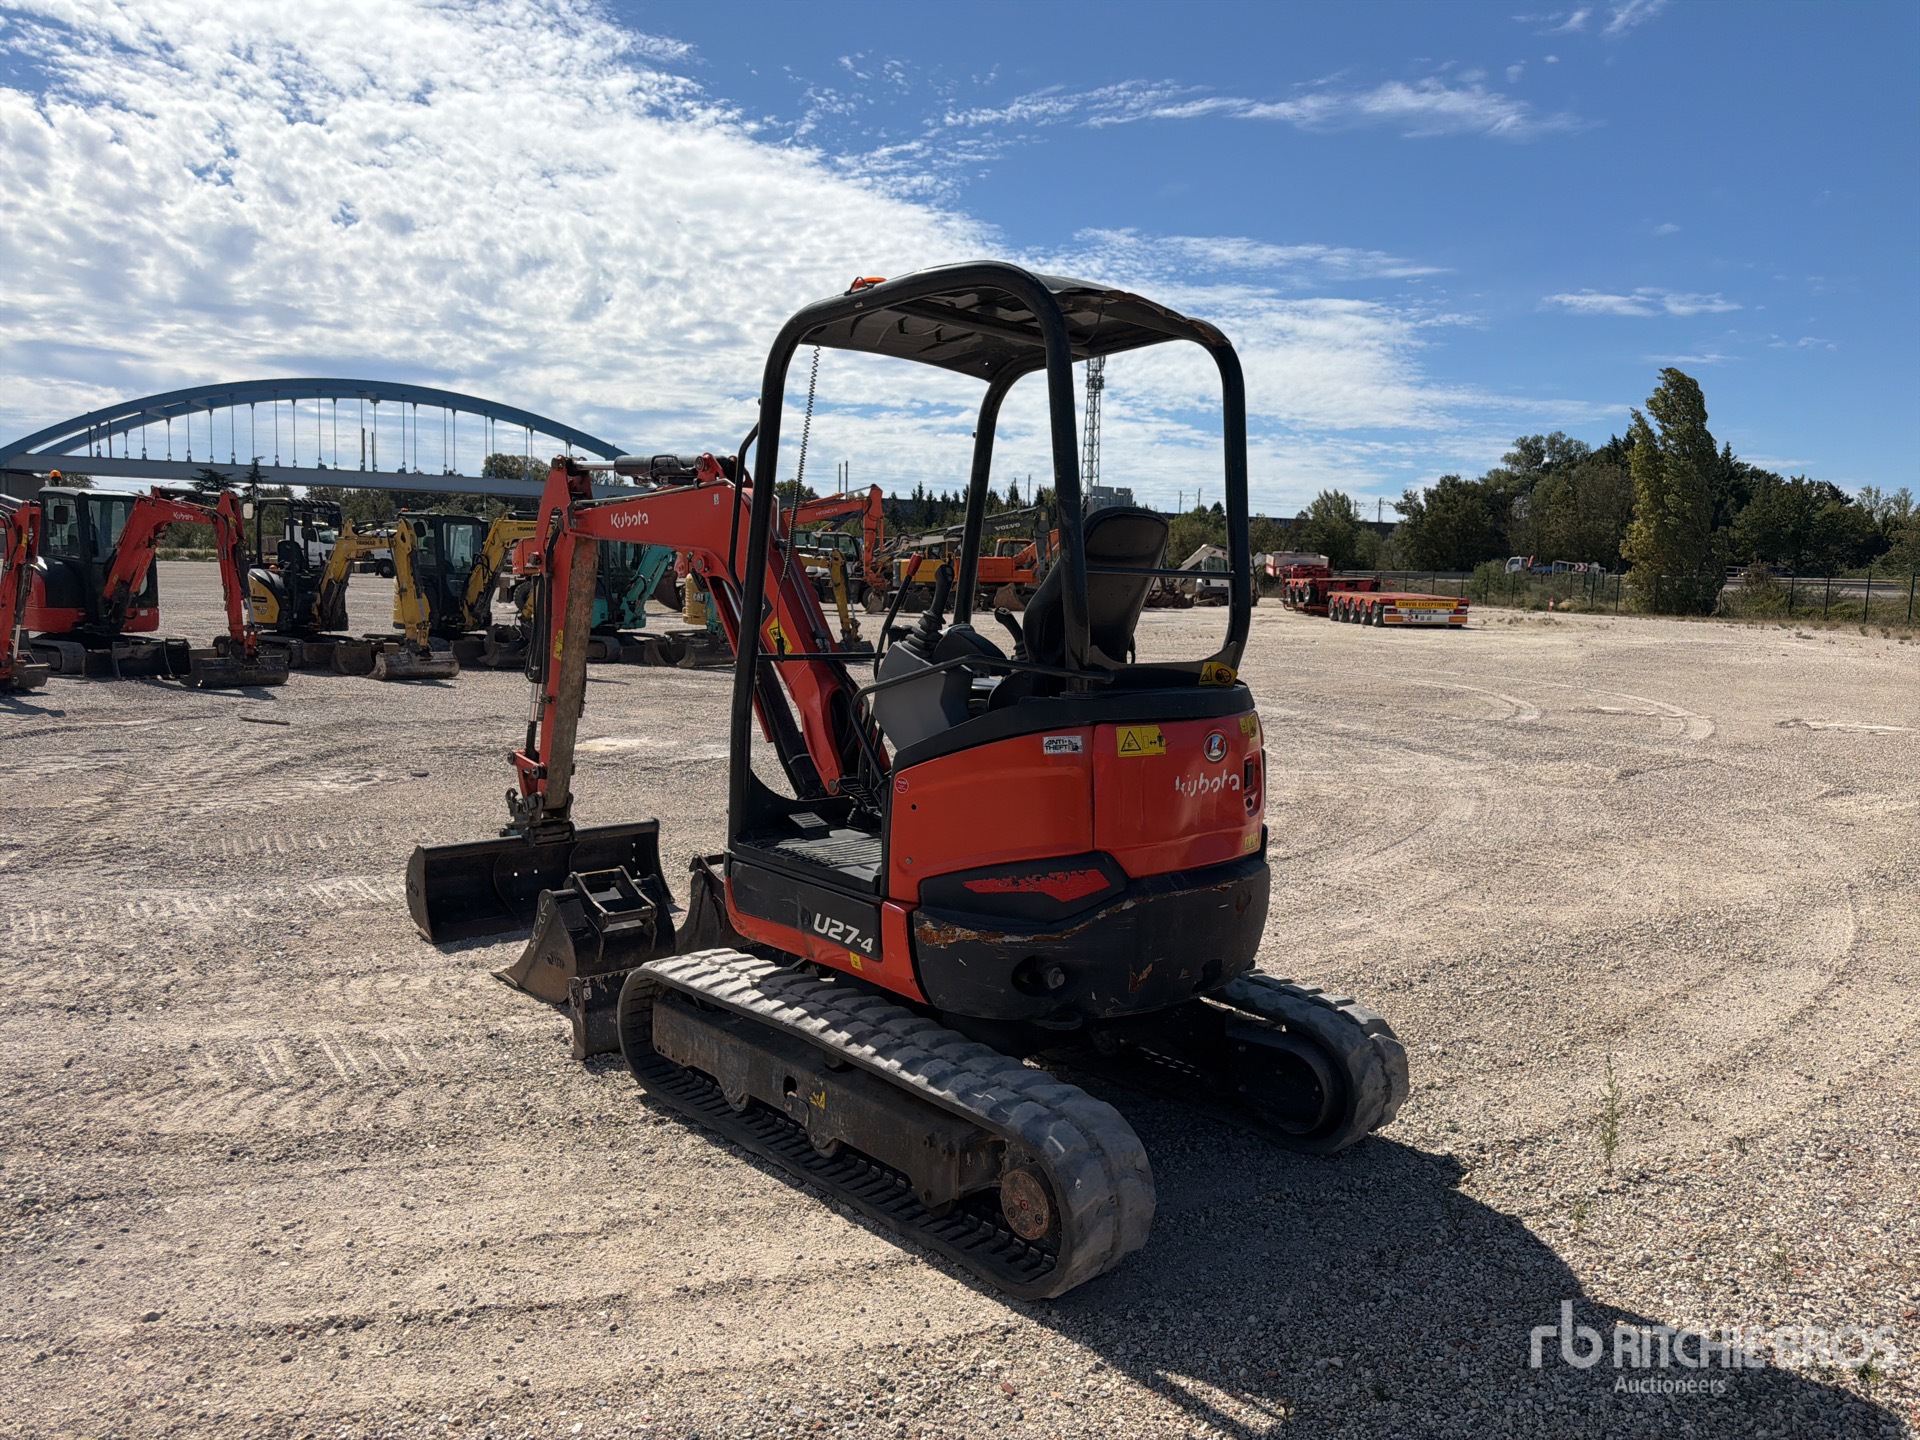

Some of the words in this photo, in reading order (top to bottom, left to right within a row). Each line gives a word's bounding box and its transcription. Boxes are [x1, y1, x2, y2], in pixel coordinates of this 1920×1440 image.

[610, 510, 649, 529] Kubota
[994, 522, 1021, 531] VOLVO
[1418, 601, 1455, 609] EXCEPTIONNEL
[813, 912, 874, 953] U27-4
